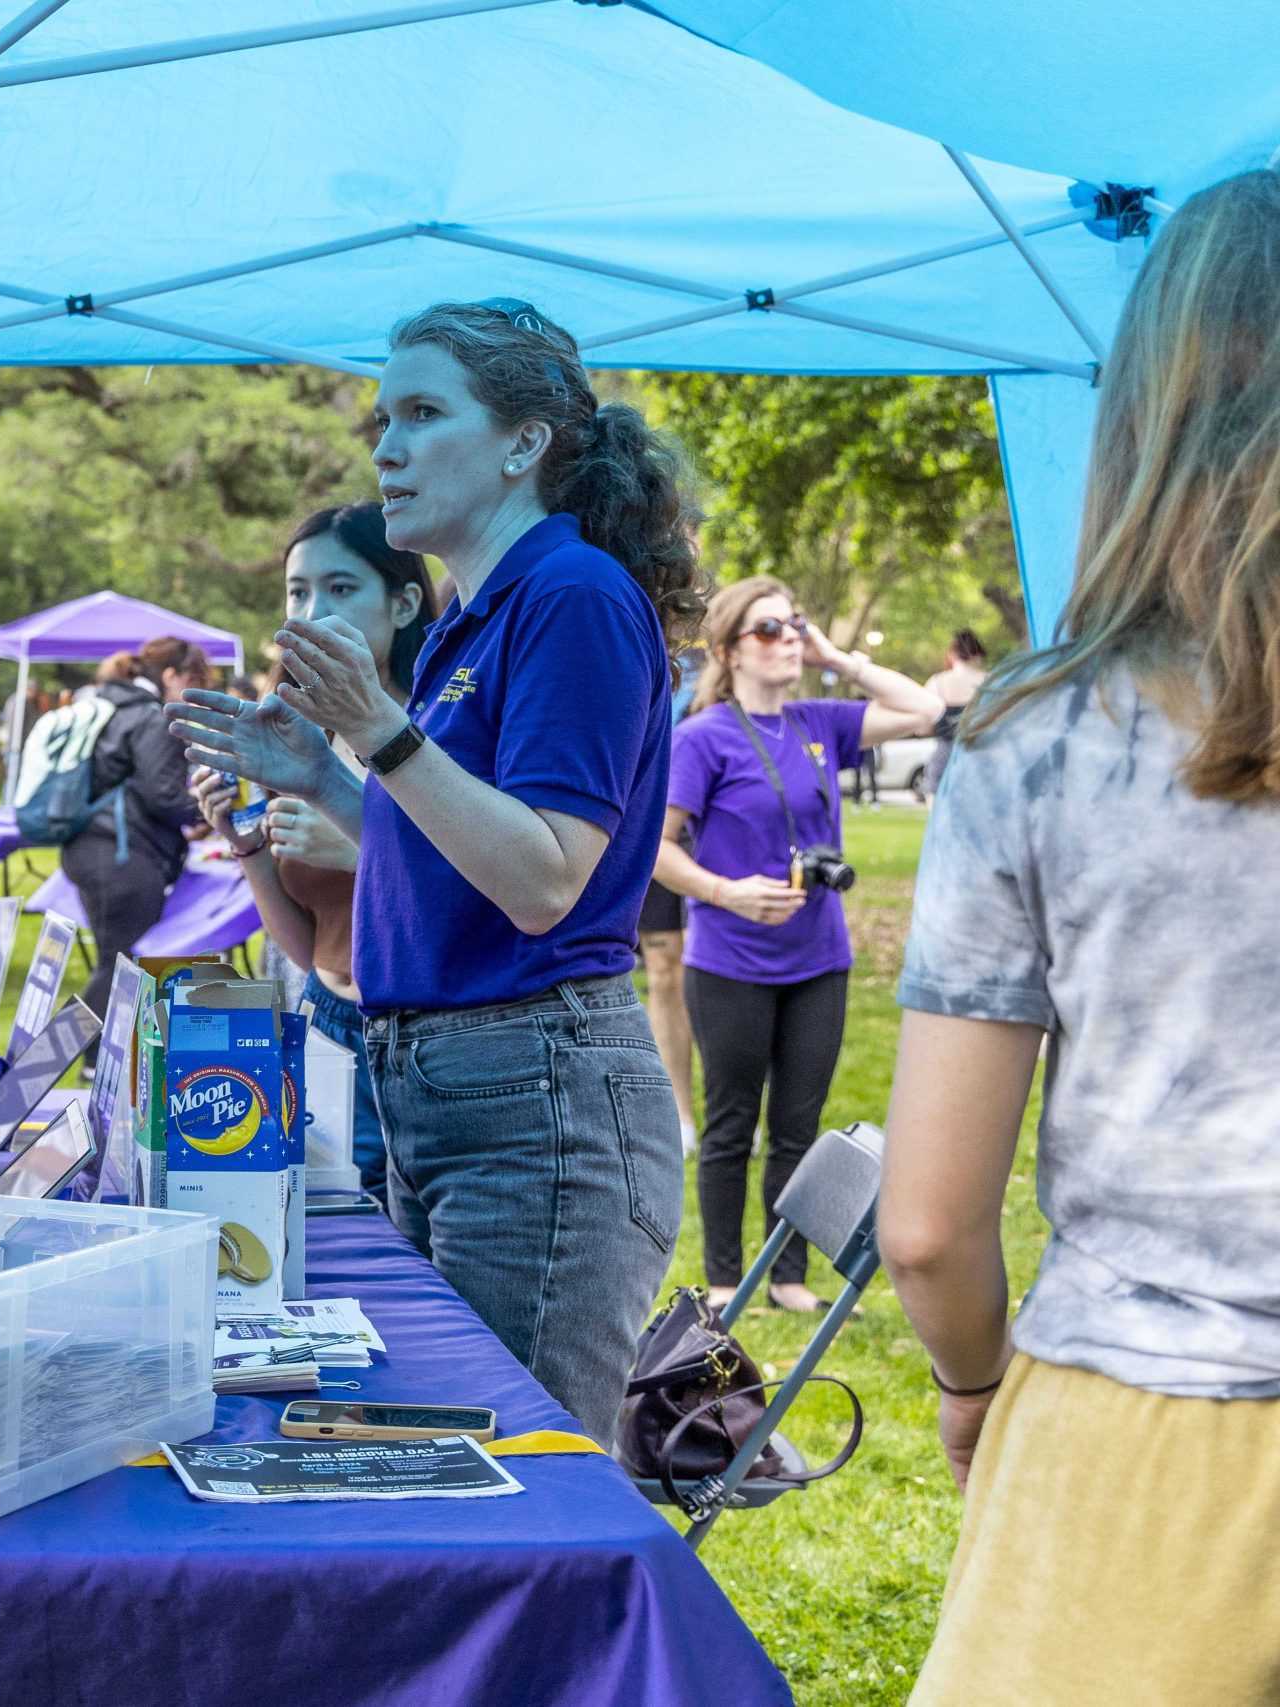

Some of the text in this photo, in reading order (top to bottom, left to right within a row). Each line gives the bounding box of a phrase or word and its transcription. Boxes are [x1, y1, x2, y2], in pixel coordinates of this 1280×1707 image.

[169, 1080, 232, 1118] Moon
[211, 1097, 247, 1126] Pie
[334, 1450, 403, 1458] DISCOVER
